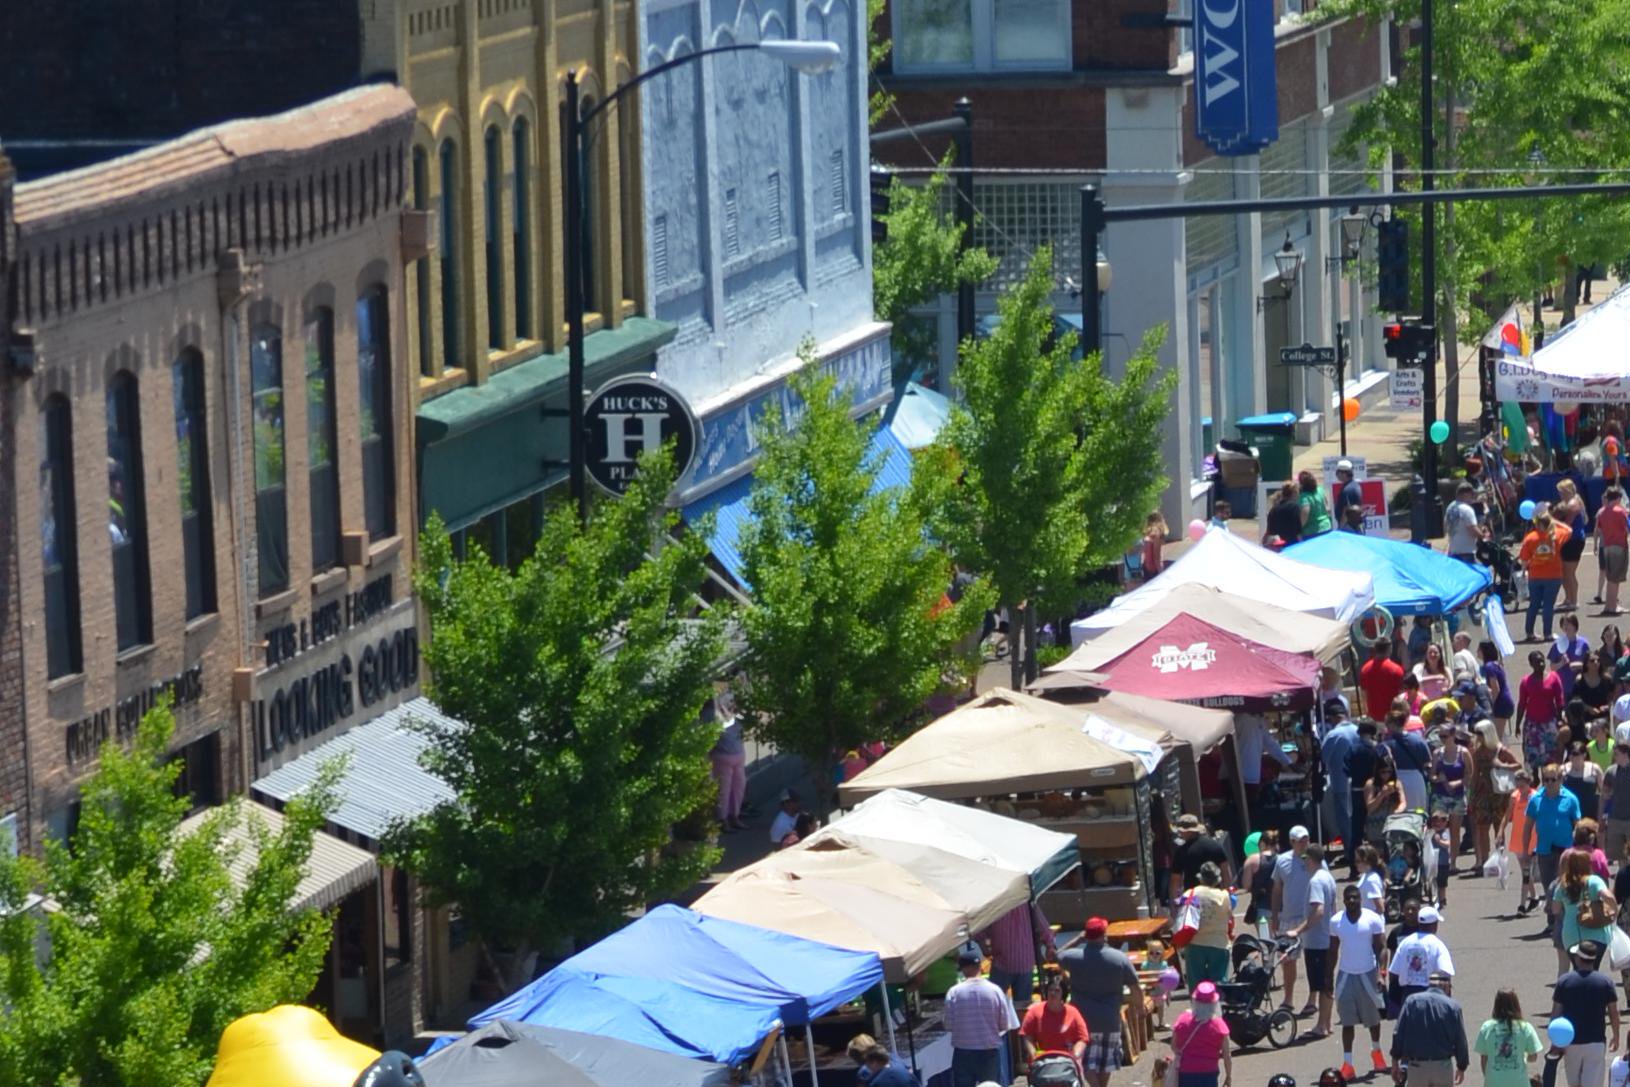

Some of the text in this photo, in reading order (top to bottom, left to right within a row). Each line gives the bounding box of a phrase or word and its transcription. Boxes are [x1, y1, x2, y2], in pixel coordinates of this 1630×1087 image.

[1281, 349, 1334, 363] College St.
[603, 397, 668, 410] HUCK'S
[598, 413, 671, 463] H
[259, 626, 418, 763] LOOKING GOOD
[1203, 695, 1245, 707] BULLDOGS
